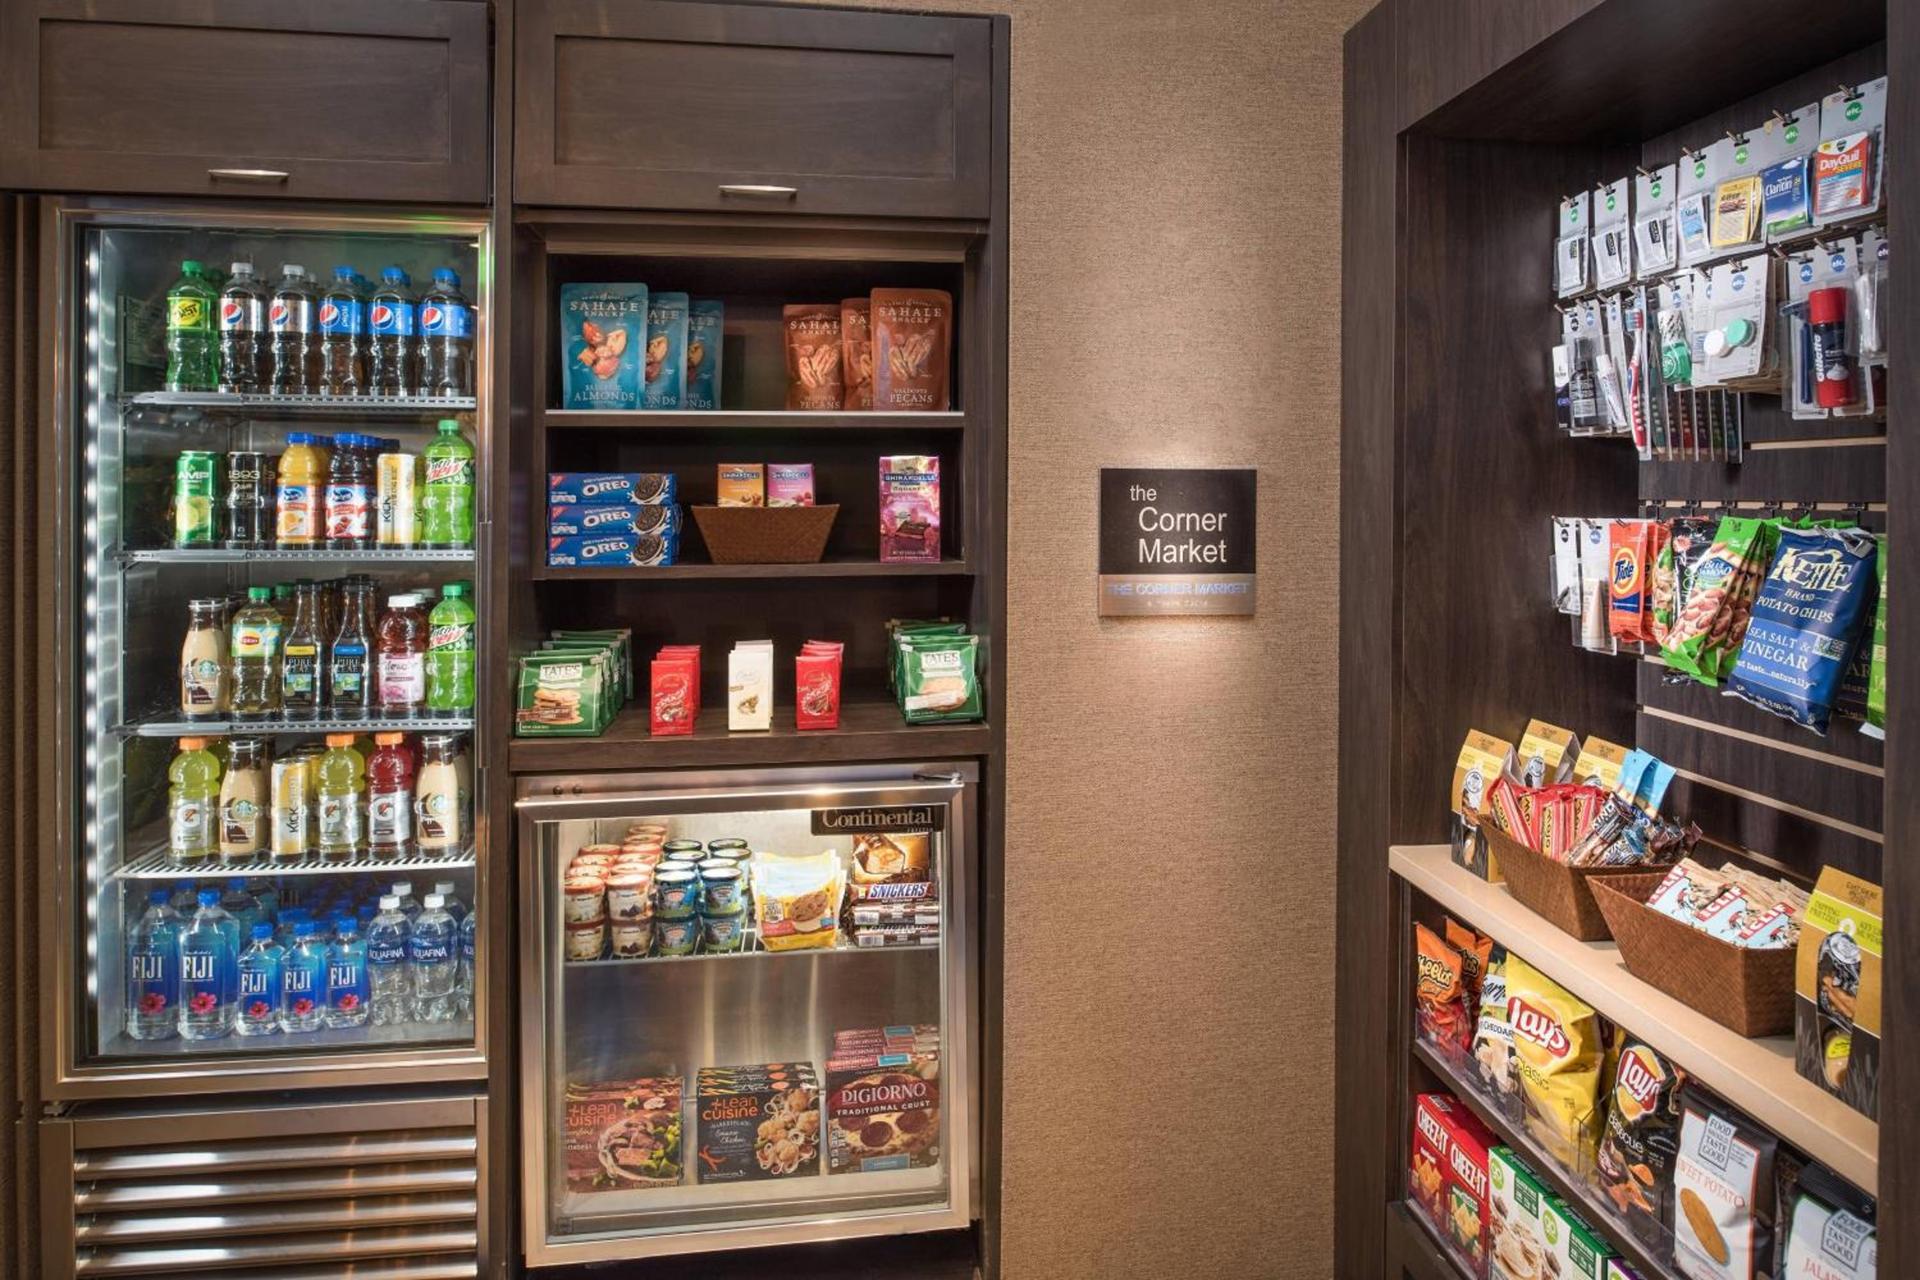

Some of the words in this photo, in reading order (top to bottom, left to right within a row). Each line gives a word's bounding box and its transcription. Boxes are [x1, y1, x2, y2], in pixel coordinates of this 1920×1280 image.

[1819, 150, 1860, 171] DayQuil
[1765, 179, 1793, 197] Claritin
[570, 301, 639, 312] SAHALE
[878, 307, 943, 318] SAHALE
[790, 320, 839, 330] SAHAL
[574, 391, 636, 402] ALMONDS
[889, 394, 934, 404] PECANS
[178, 471, 210, 480] AMP
[228, 470, 261, 480] 1893
[582, 480, 630, 496] OREO
[1130, 485, 1157, 501] the
[583, 511, 631, 527] OREO
[1138, 506, 1228, 532] Corner
[582, 541, 629, 557] OREO
[1138, 538, 1227, 563] Market
[1614, 559, 1635, 585] Tide
[1767, 547, 1854, 593] KETTLE
[1136, 583, 1192, 595] CORNER
[1194, 583, 1249, 595] MARKET
[1784, 587, 1816, 602] BRAND
[1756, 594, 1800, 616] POTATO
[1799, 606, 1835, 624] CHIPS
[1749, 625, 1768, 640] SEA
[1768, 629, 1796, 649] SALT
[1801, 642, 1812, 652] &
[288, 658, 312, 666] PURE
[337, 658, 360, 666] PURE
[924, 651, 960, 665] TATE'S
[1741, 637, 1810, 672] VINEGAR
[542, 664, 581, 677] TATE'S
[822, 807, 933, 829] Continental
[870, 883, 927, 898] SNICKERS
[1703, 885, 1744, 919] CLIF
[1750, 904, 1788, 934] CLIF
[131, 956, 163, 979] FIJI
[182, 955, 214, 979] FIJI
[329, 966, 357, 986] FIJI
[241, 973, 268, 992] FIJI
[284, 970, 312, 990] FIJI
[1509, 997, 1565, 1050] Lay's
[1619, 1051, 1661, 1101] Lay's
[842, 1082, 927, 1104] DIGIORNO
[836, 1104, 898, 1116] TRADITIONAL
[901, 1100, 931, 1109] CRUST
[1709, 1118, 1732, 1137] FOOD
[1702, 1144, 1725, 1164] GOOD
[1705, 1135, 1727, 1154] TASTE
[1703, 1175, 1745, 1209] POTATO
[1829, 1226, 1857, 1251] TASTE
[1826, 1239, 1854, 1262] GOOD
